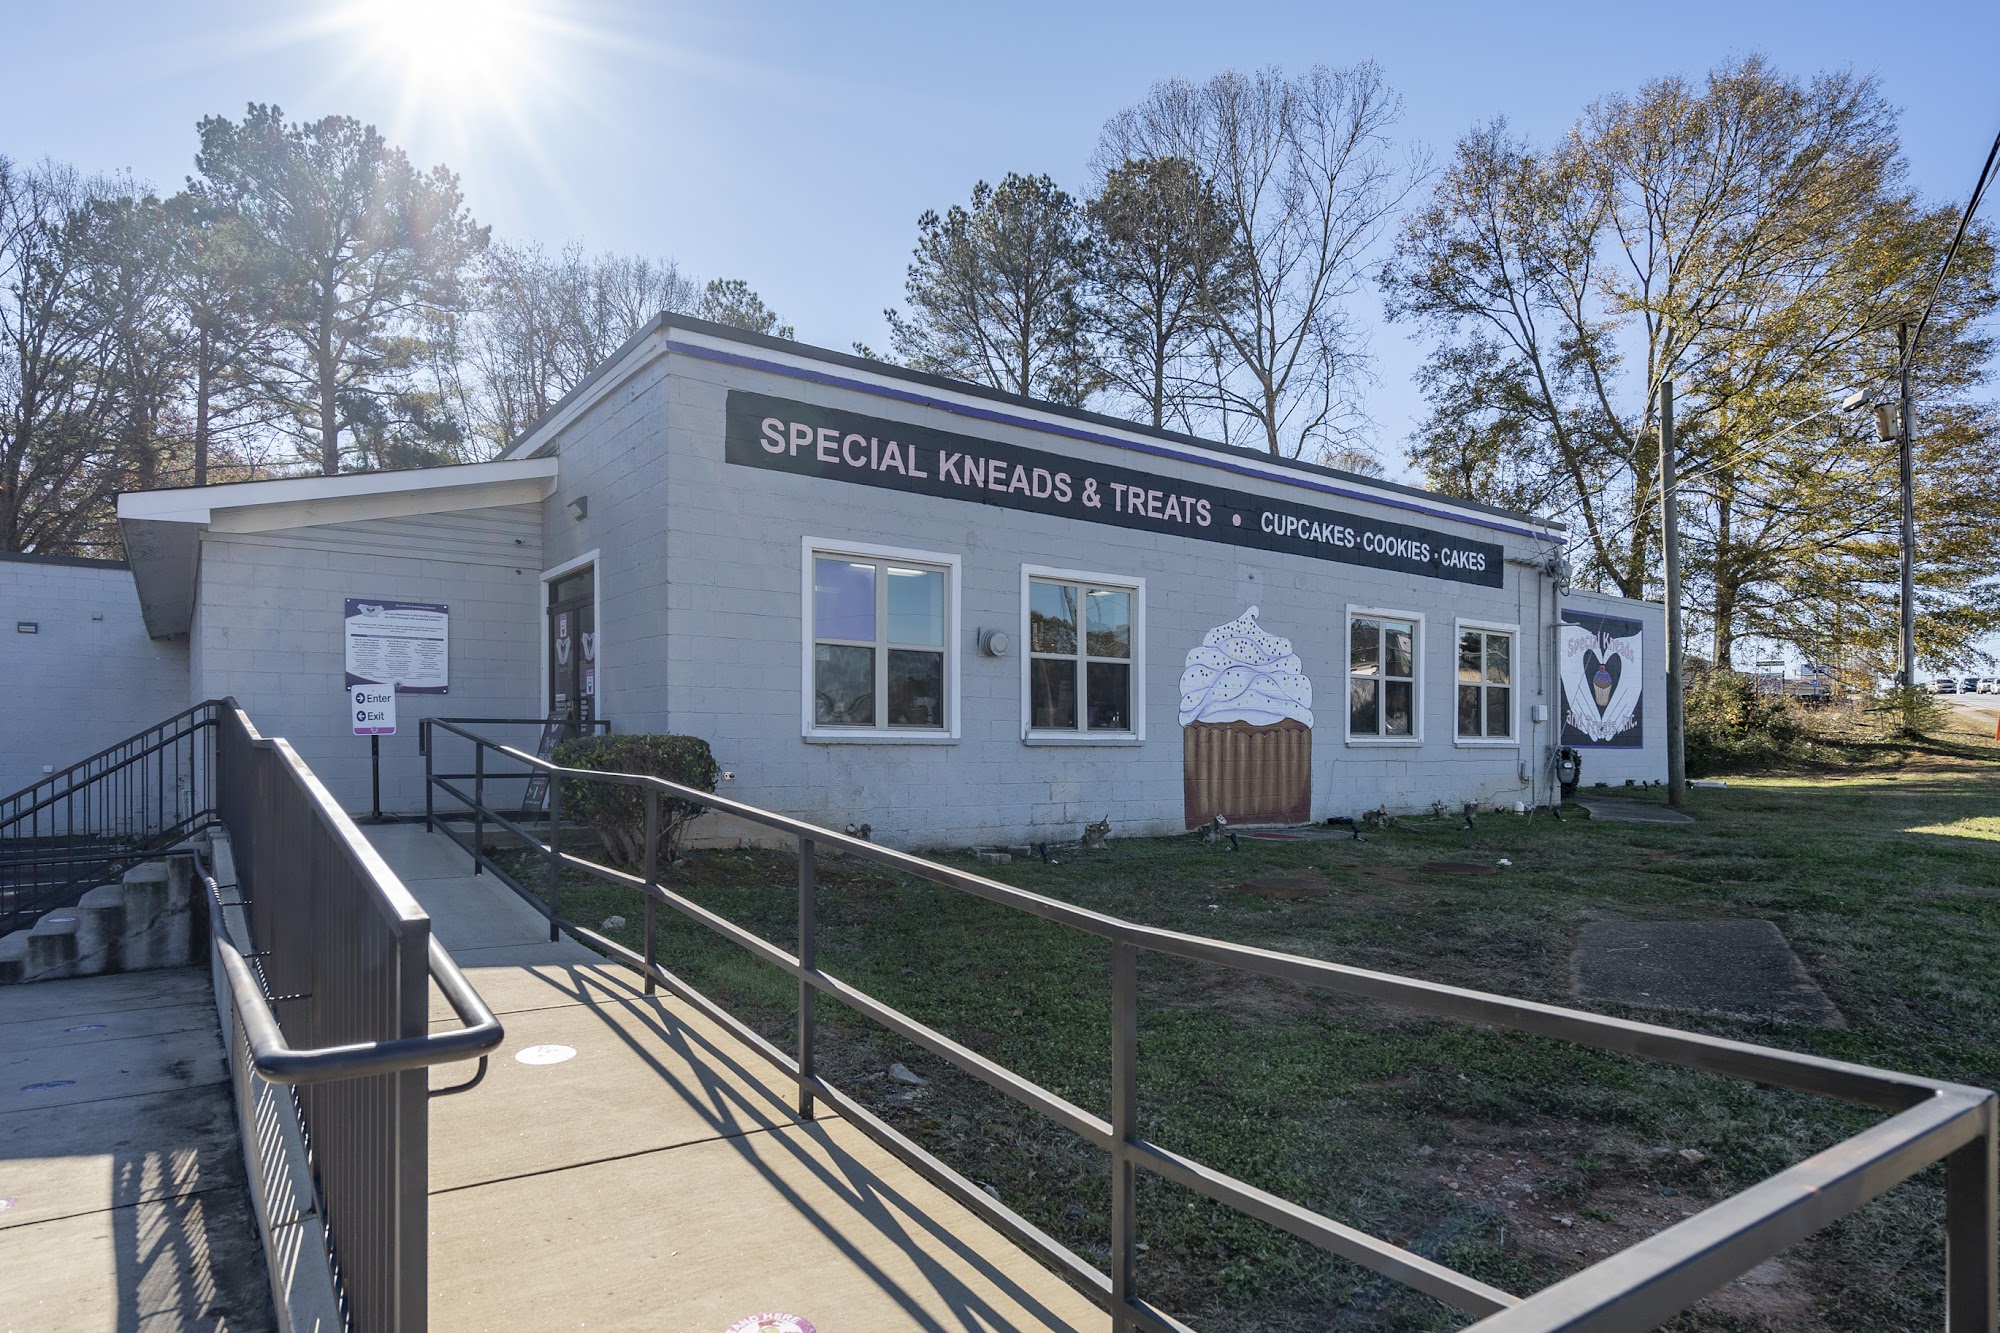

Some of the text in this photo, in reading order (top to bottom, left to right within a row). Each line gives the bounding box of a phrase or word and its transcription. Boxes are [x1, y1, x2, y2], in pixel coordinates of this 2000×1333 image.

[760, 416, 1212, 527] SPECIAL KNEADS & TREATS
[1260, 511, 1486, 571] CUPCAKES COOKIES CAKES
[1567, 631, 1635, 663] Special Kneads
[367, 694, 391, 703] Enter
[367, 711, 385, 721] Exit
[726, 1312, 802, 1333] AND HERE
